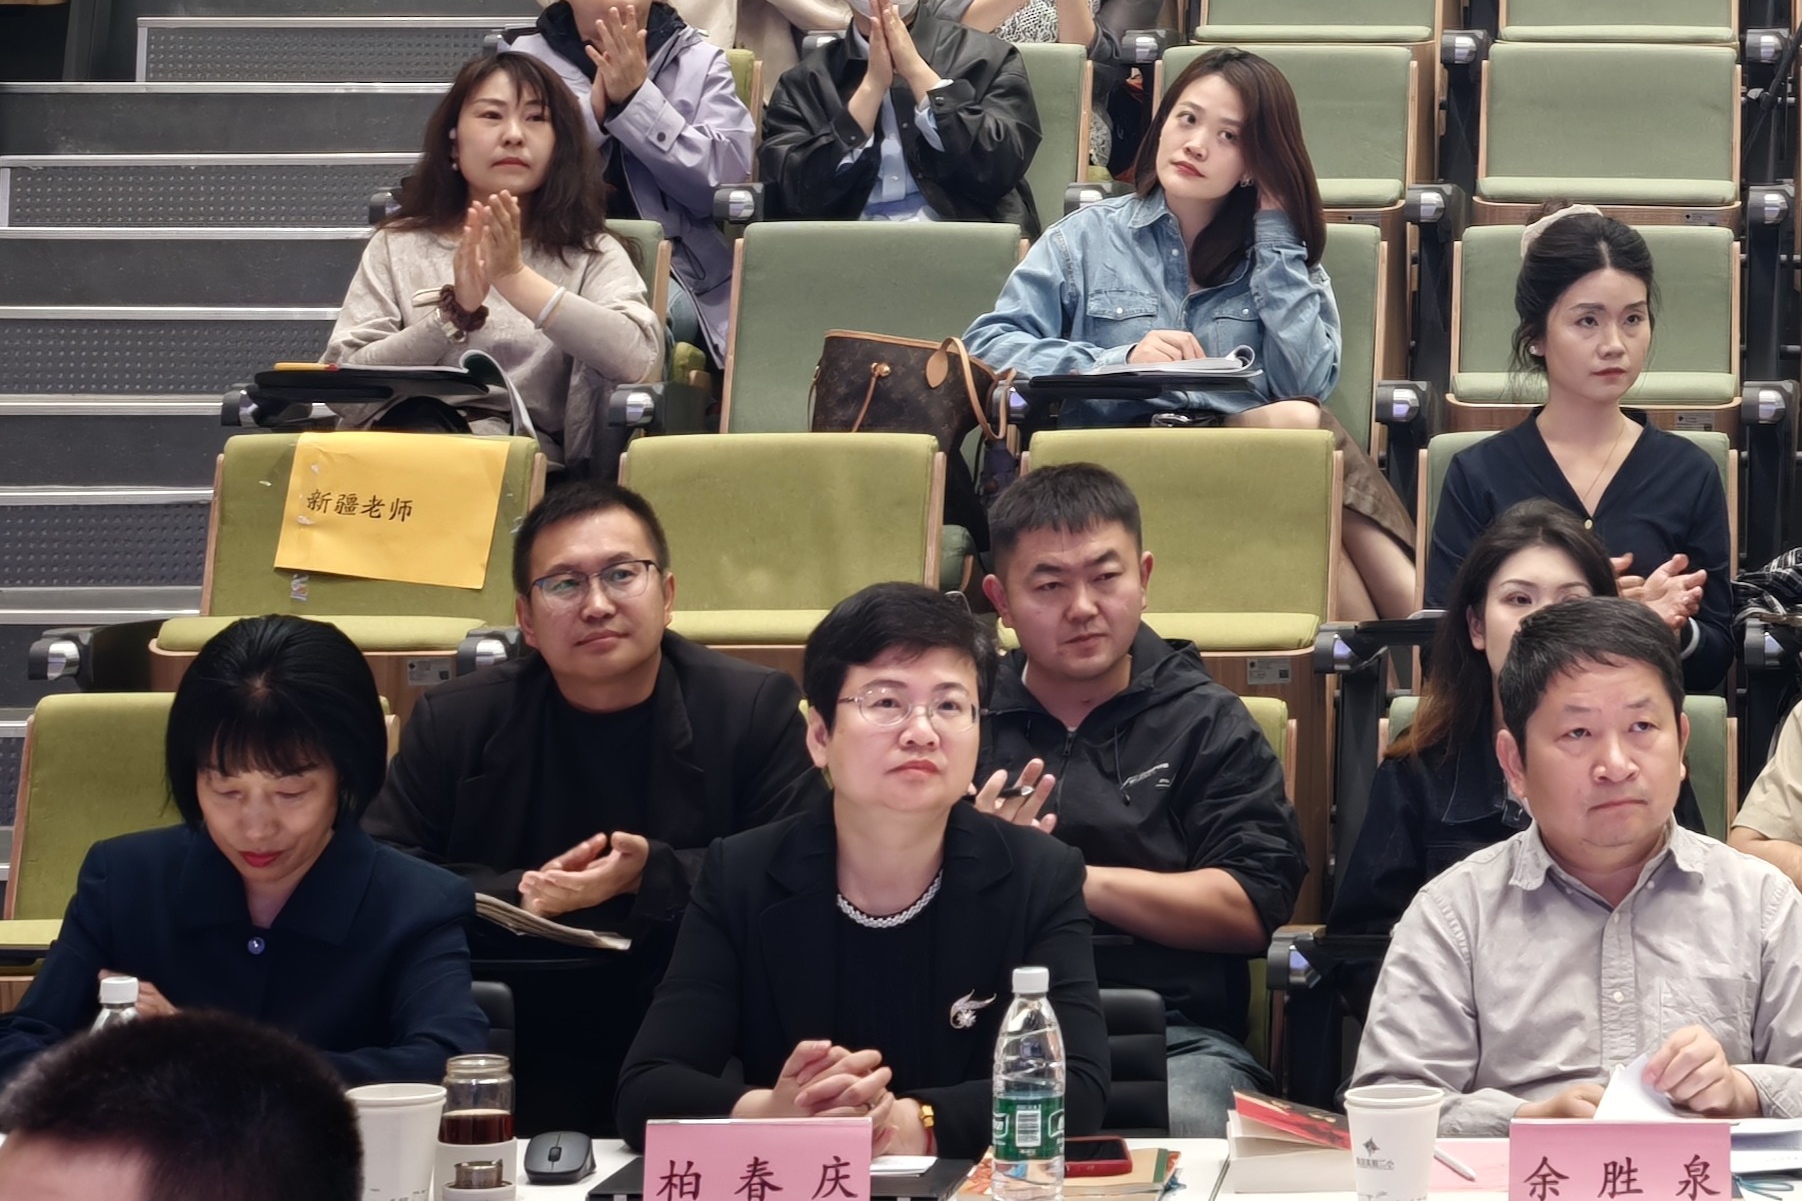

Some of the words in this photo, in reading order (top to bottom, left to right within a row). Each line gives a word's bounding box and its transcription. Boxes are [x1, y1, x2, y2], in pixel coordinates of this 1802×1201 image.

[306, 488, 414, 523] 新疆老师
[655, 1155, 859, 1201] 柏春庆
[1523, 1153, 1721, 1201] 余胜泉
